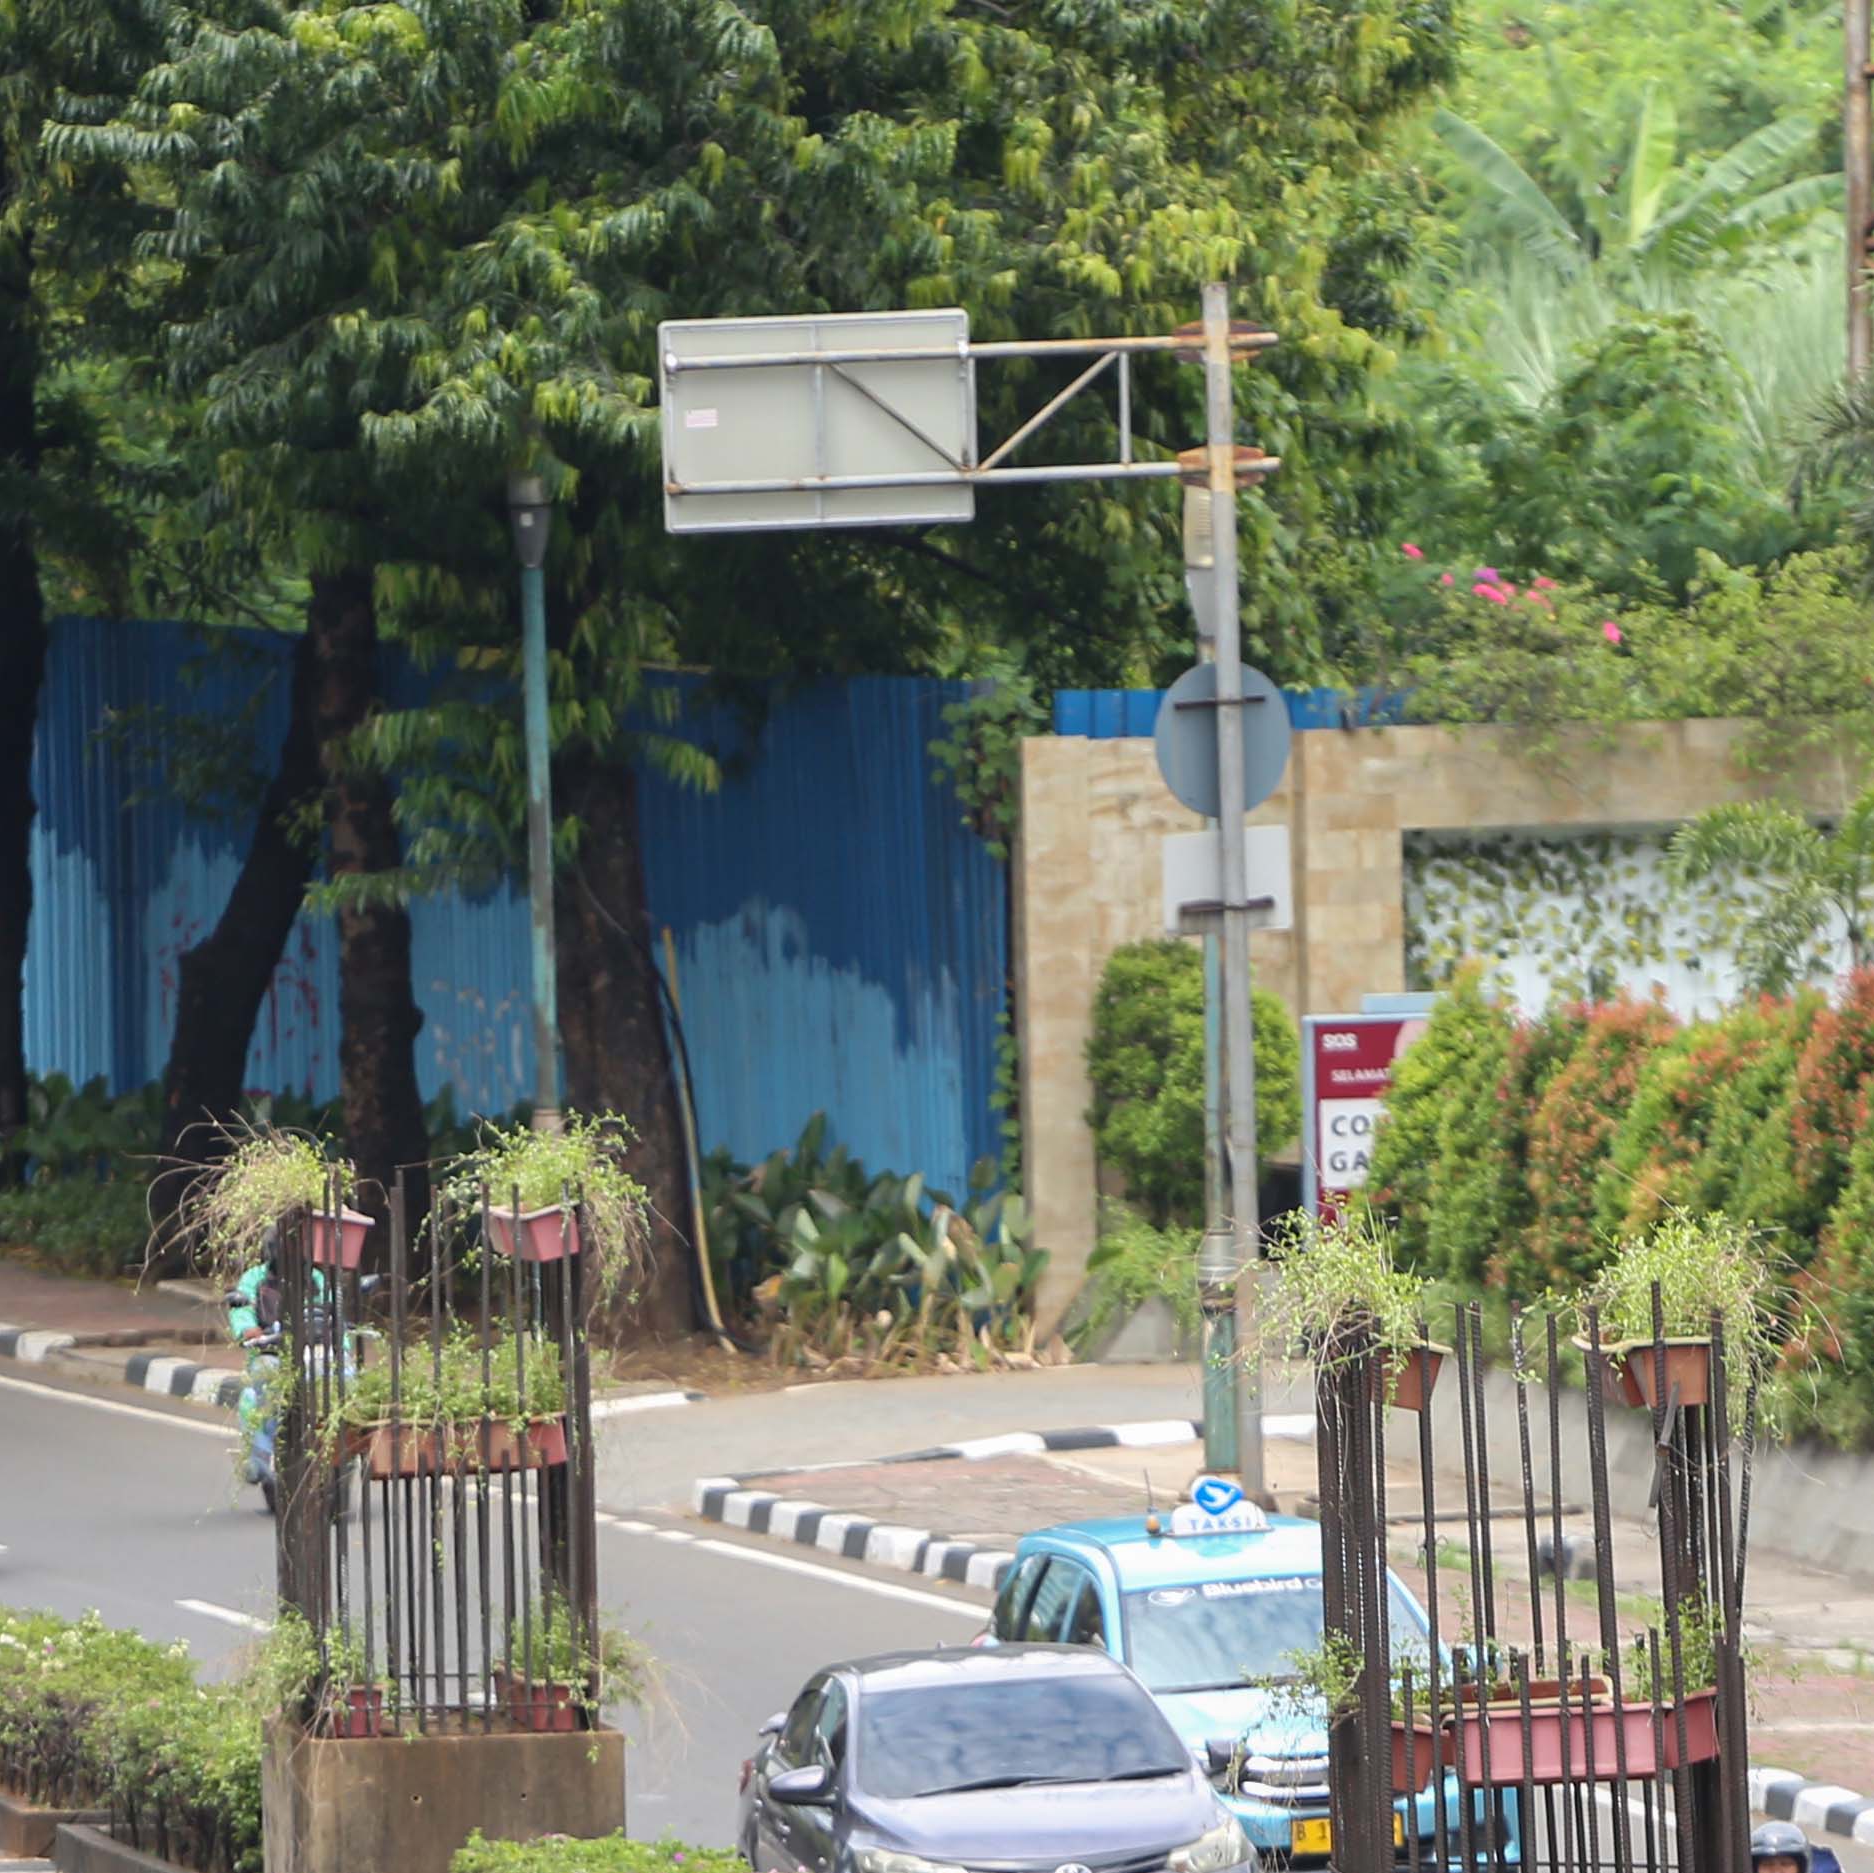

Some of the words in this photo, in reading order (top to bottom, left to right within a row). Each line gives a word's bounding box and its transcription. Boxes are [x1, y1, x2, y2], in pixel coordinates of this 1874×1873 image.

[1322, 1034, 1357, 1048] SOS
[1190, 1519, 1253, 1531] TAKSI
[1202, 1576, 1304, 1598] Bluebird
